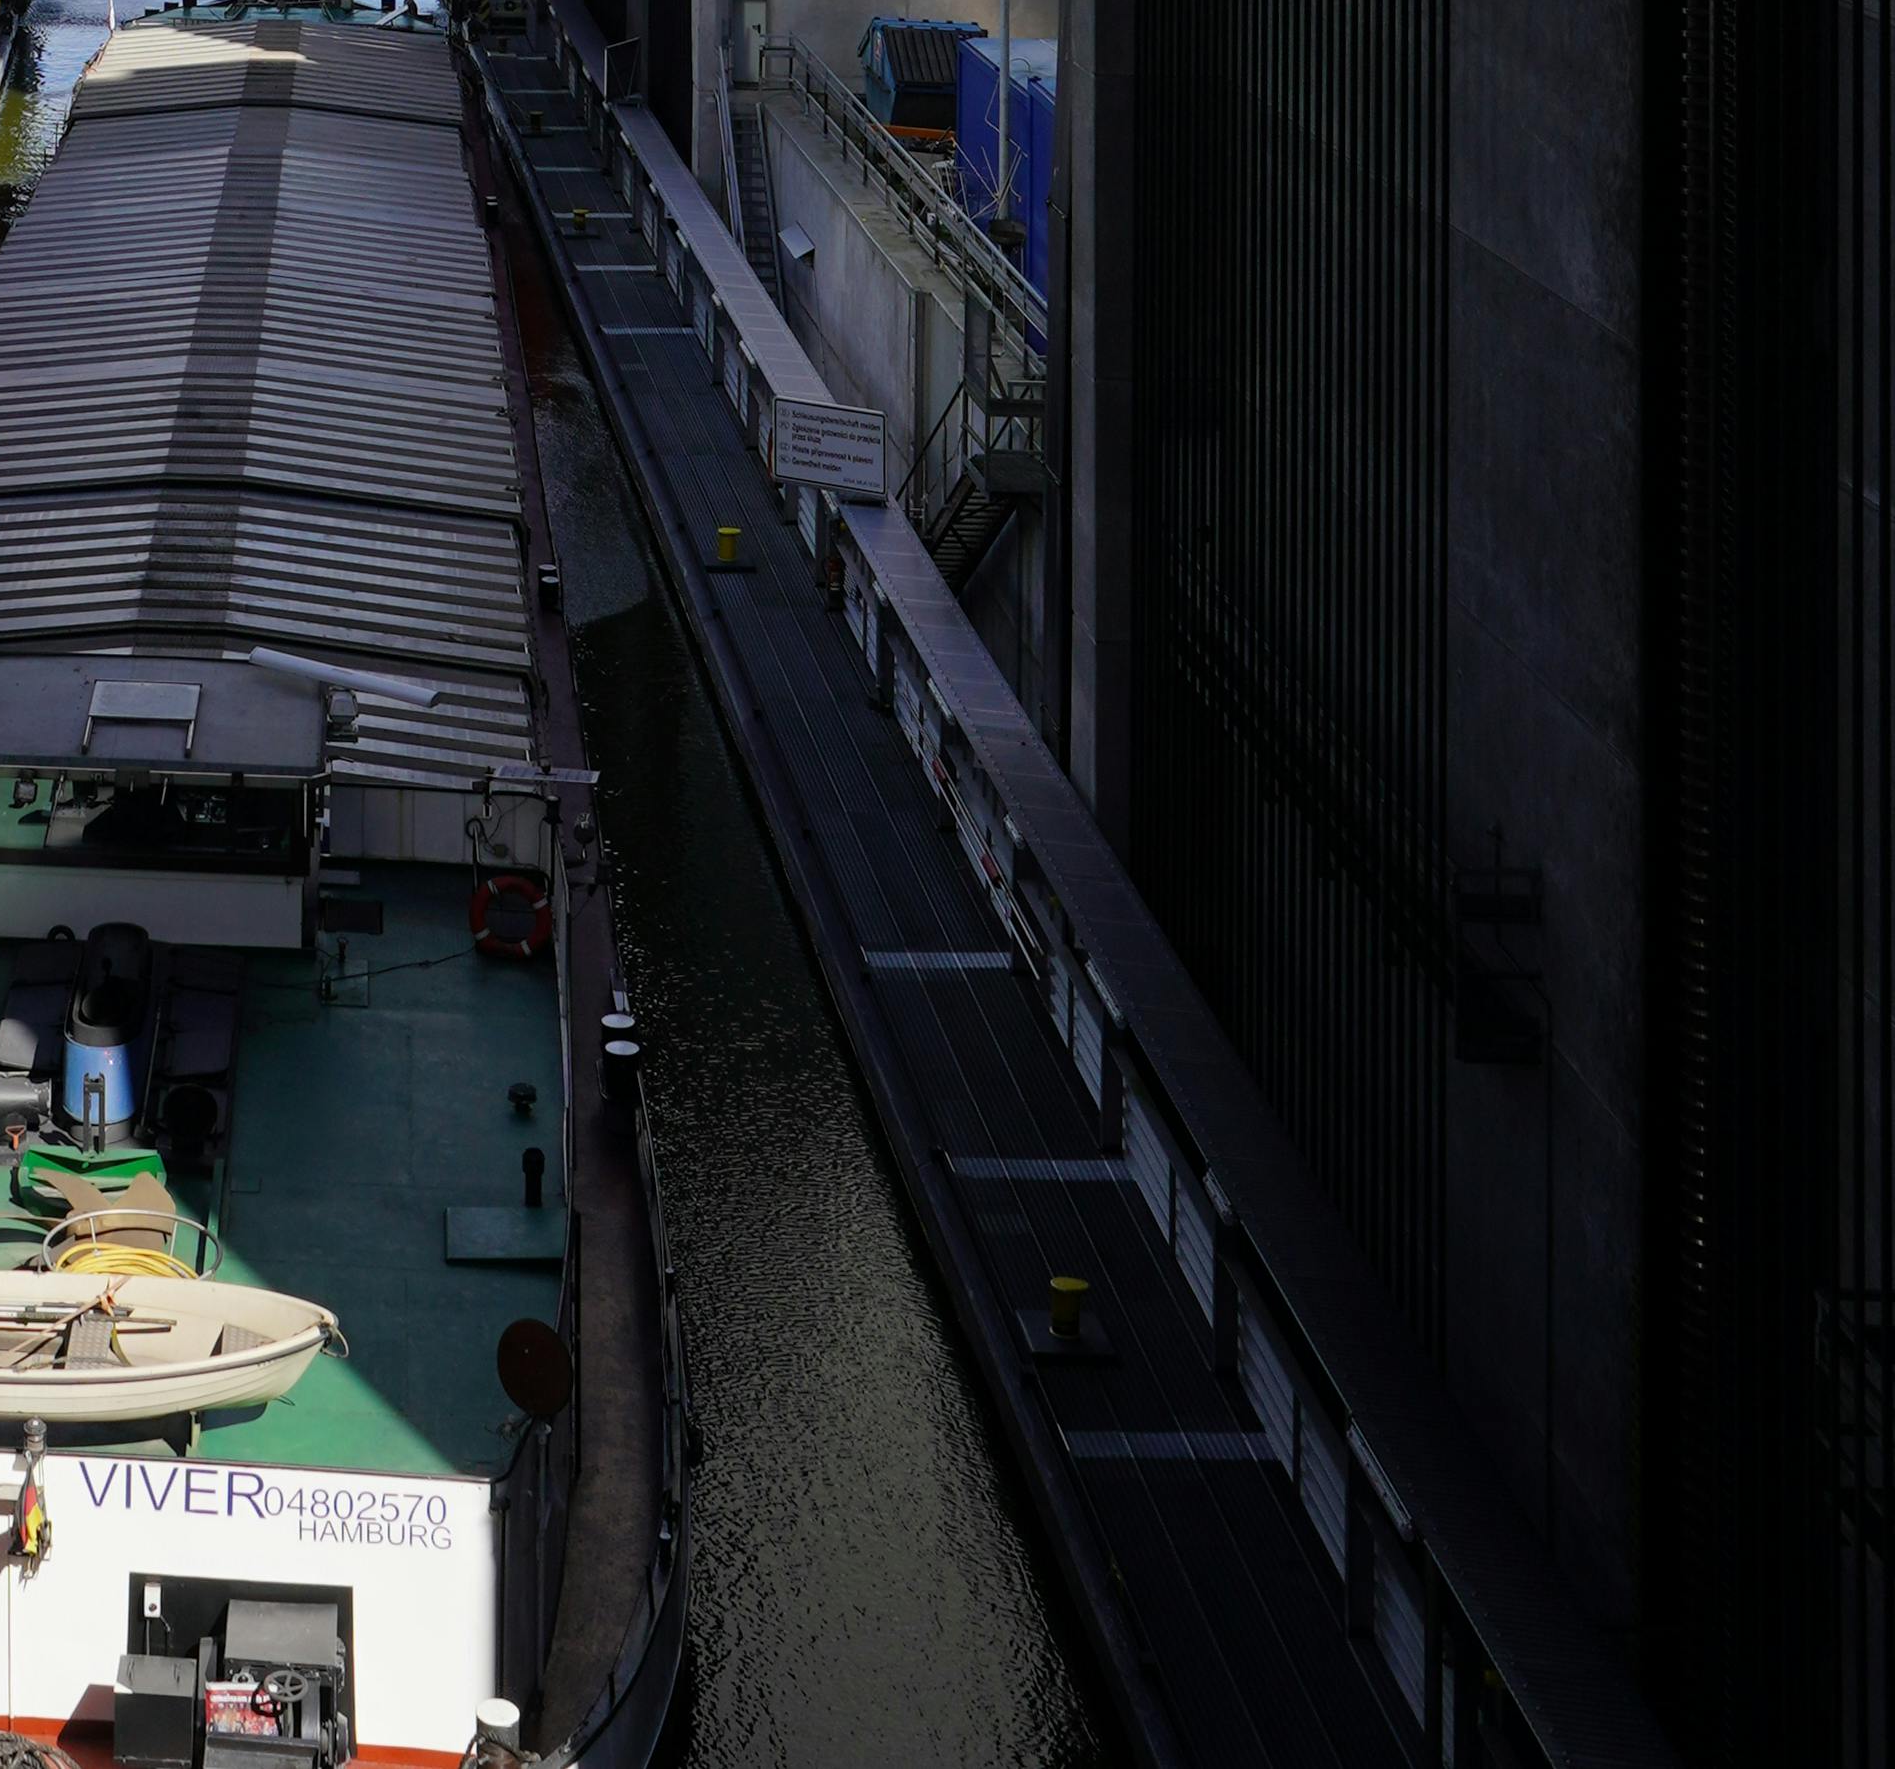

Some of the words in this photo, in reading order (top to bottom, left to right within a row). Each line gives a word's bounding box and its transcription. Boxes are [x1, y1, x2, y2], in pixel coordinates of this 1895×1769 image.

[79, 1461, 265, 1519] VIVER
[264, 1485, 446, 1526] 04802570
[298, 1519, 452, 1550] HAMBURG
